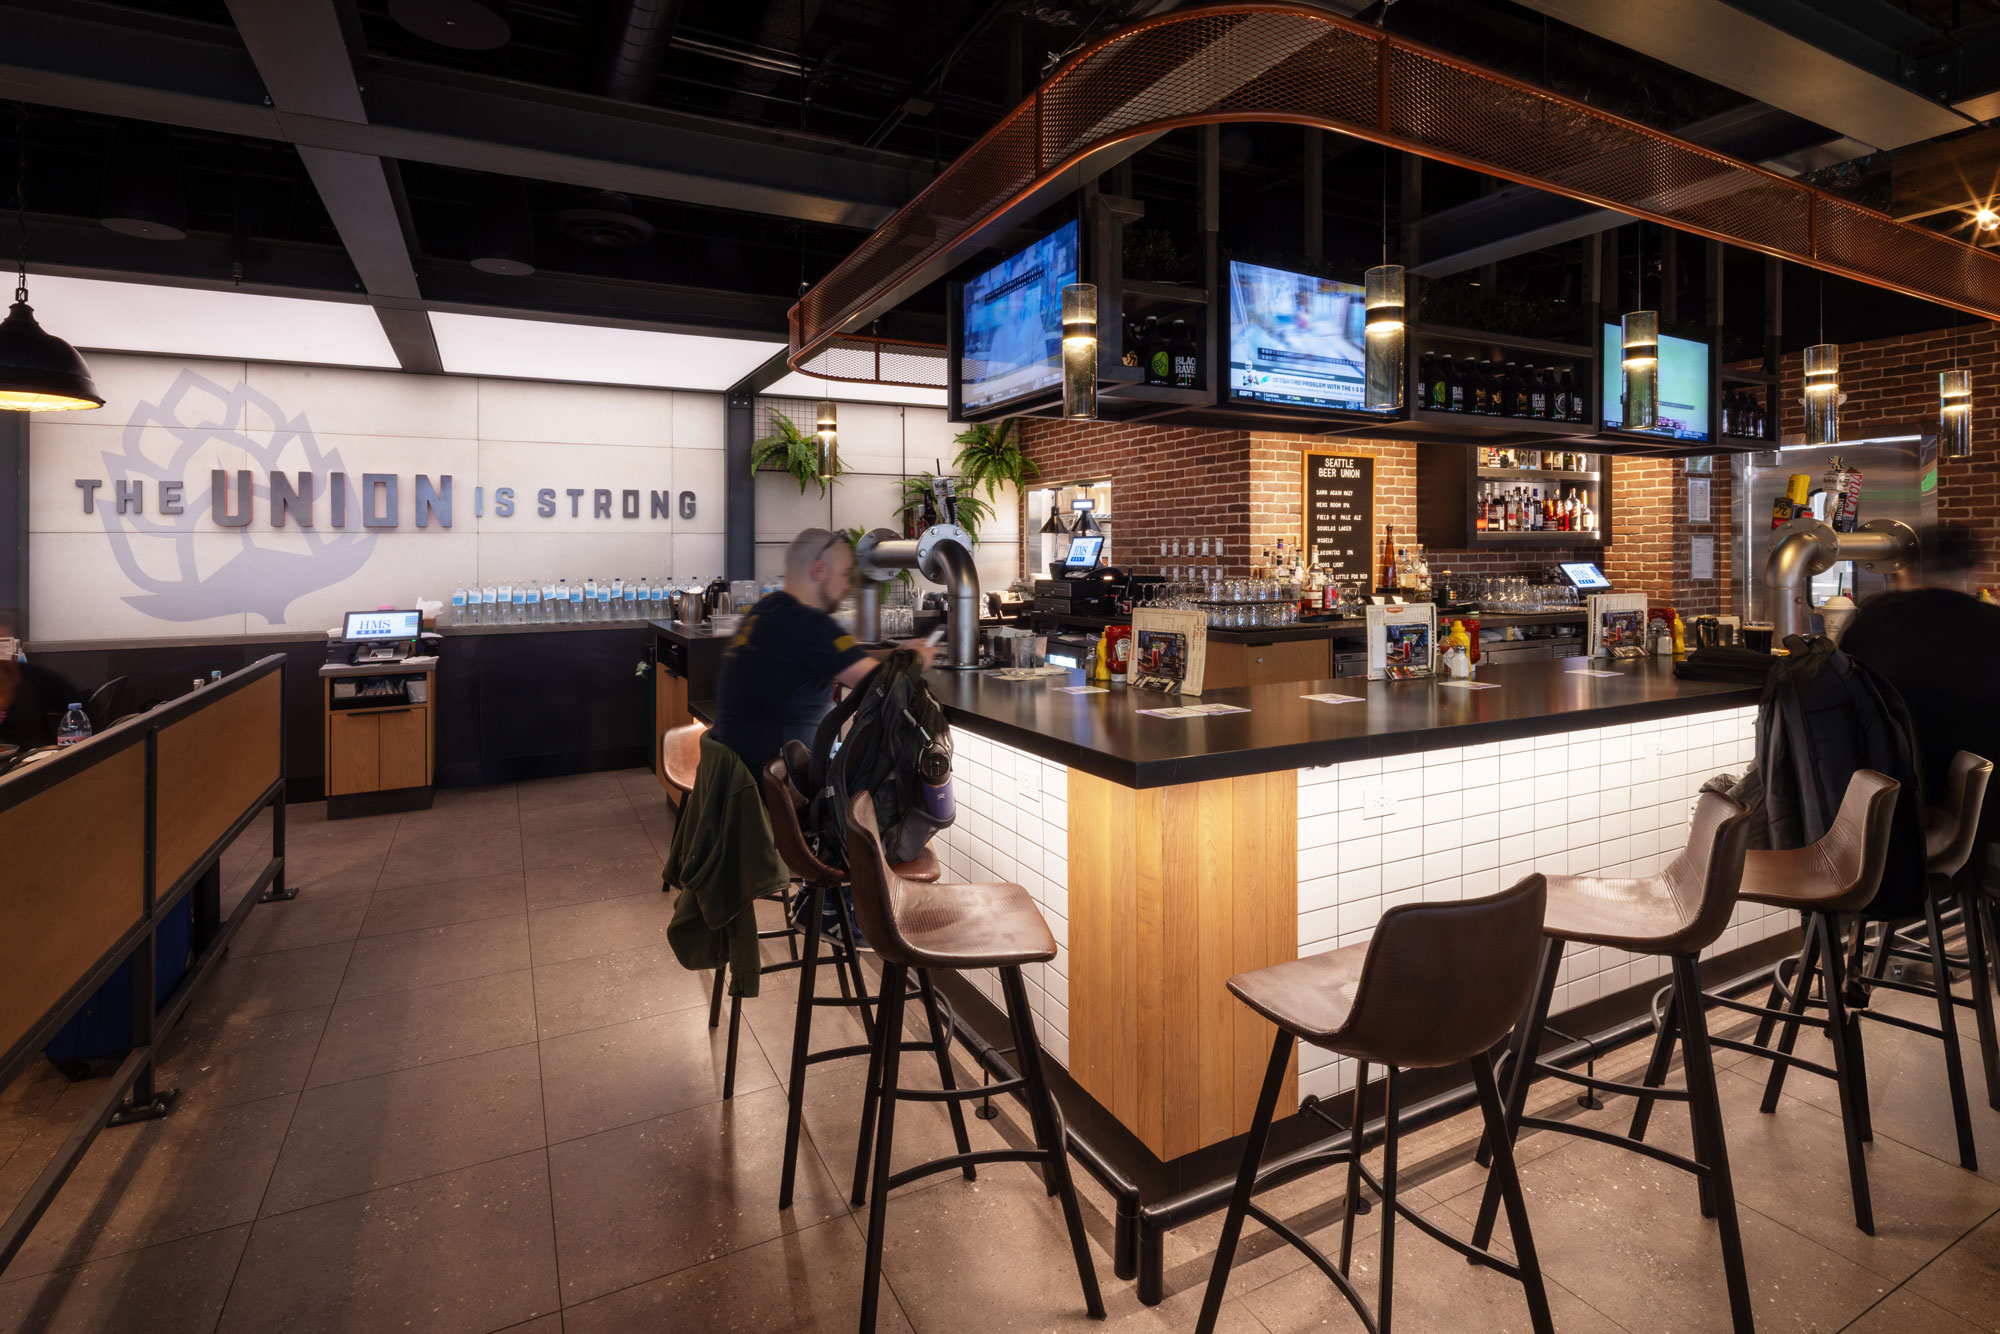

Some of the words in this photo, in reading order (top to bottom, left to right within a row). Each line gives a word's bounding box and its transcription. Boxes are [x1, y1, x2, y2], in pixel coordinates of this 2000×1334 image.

[1302, 380, 1327, 389] PROBLEM
[1325, 458, 1354, 468] SEATTLE
[1318, 468, 1337, 478] BEER
[1340, 468, 1360, 478] UNION
[75, 479, 184, 515] THE
[211, 469, 453, 528] UNION
[475, 486, 515, 518] IS
[537, 488, 696, 519] STRONG
[359, 620, 391, 630] HMS
